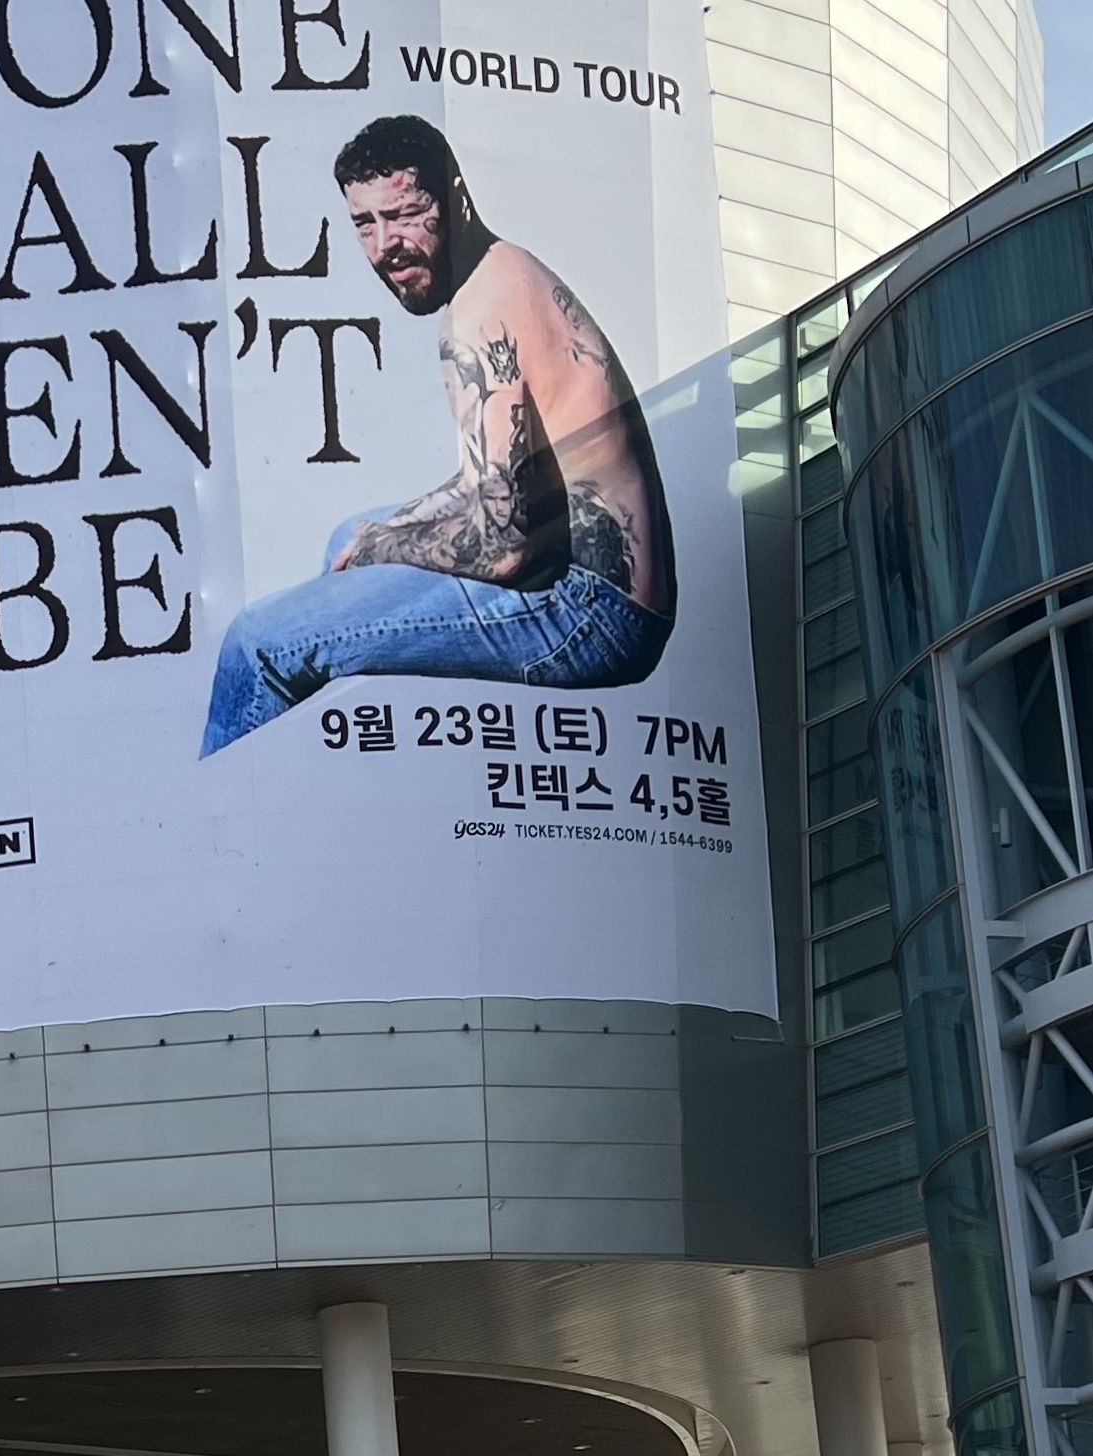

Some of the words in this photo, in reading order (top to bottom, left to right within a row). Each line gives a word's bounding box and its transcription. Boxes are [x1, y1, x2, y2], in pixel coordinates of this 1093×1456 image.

[399, 46, 560, 94] WORLD
[573, 61, 682, 115] TOUR
[321, 703, 397, 753] 9월
[414, 703, 517, 751] 23일
[534, 704, 607, 757] (토)
[637, 715, 728, 765] 7PM
[486, 762, 614, 812] 킨텍스
[629, 774, 732, 827] 4,5홀
[514, 823, 648, 845] TICKET.YES24.COM
[660, 831, 733, 854] 1544-6399
